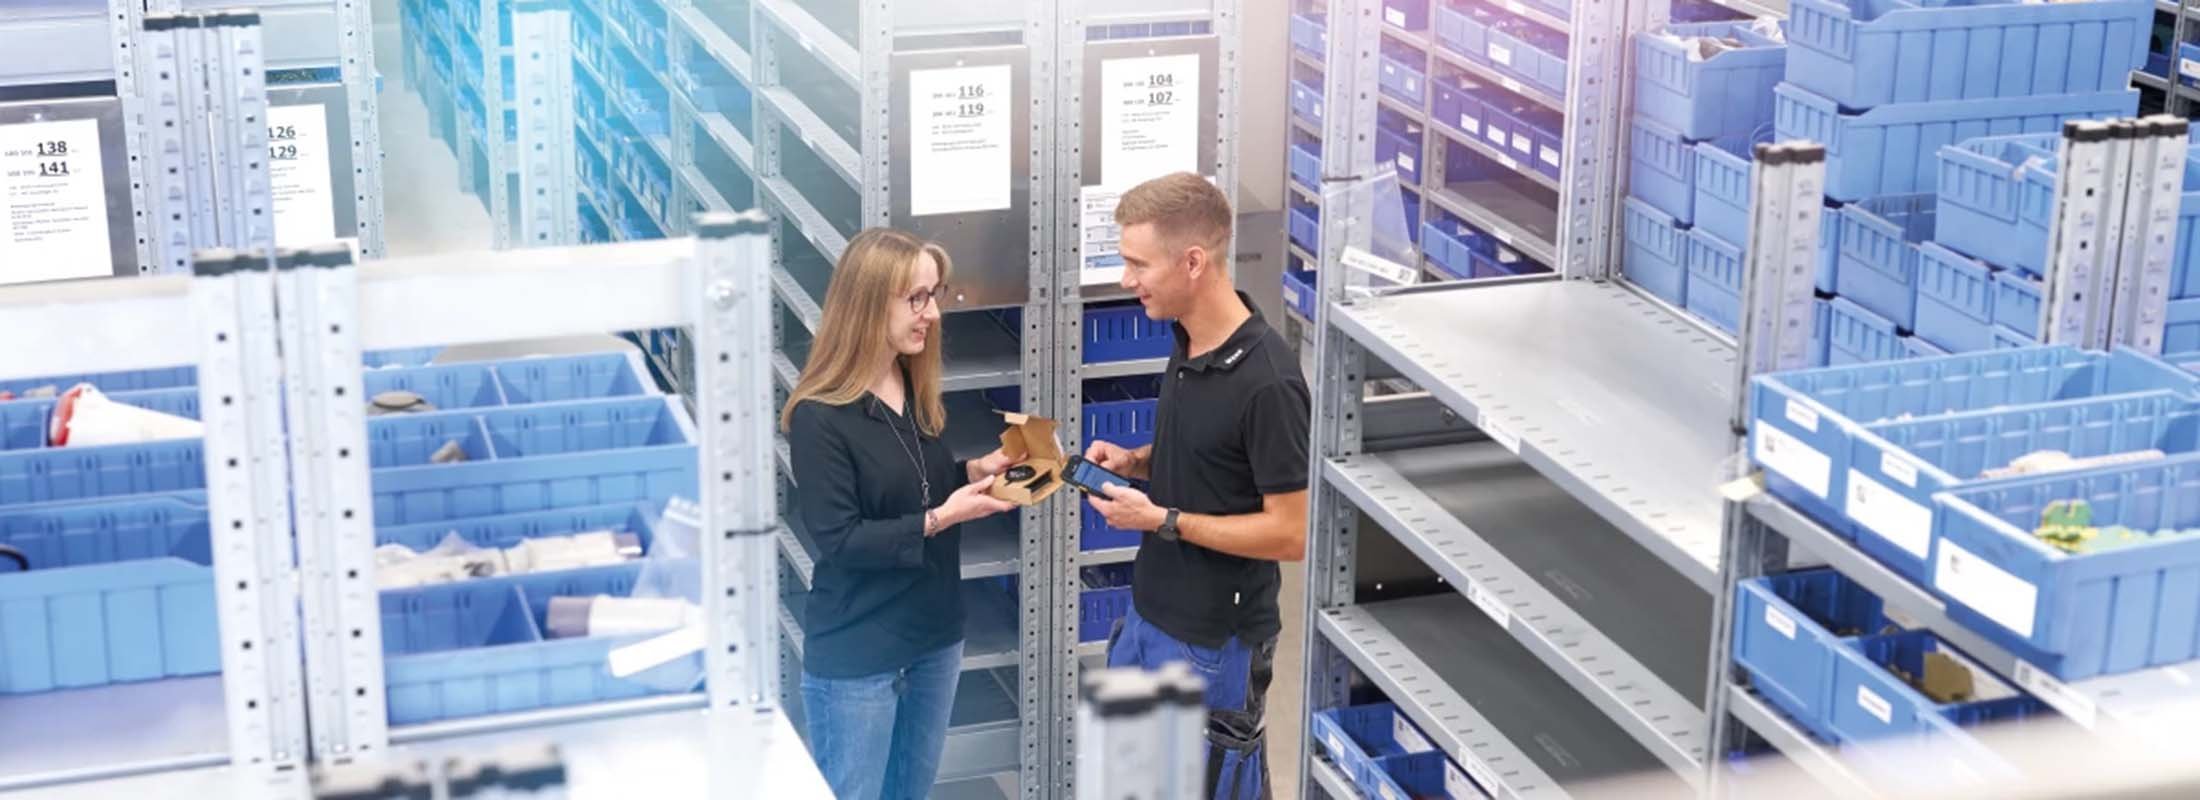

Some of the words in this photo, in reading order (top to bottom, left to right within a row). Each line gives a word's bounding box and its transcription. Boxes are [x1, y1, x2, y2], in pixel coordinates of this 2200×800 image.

[1148, 74, 1173, 87] 104
[959, 84, 985, 97] 116
[1148, 91, 1173, 104] 107
[959, 102, 985, 116] 119
[267, 125, 297, 139] 126
[37, 140, 68, 155] 138
[269, 145, 298, 159] 129
[40, 161, 70, 176] 141
